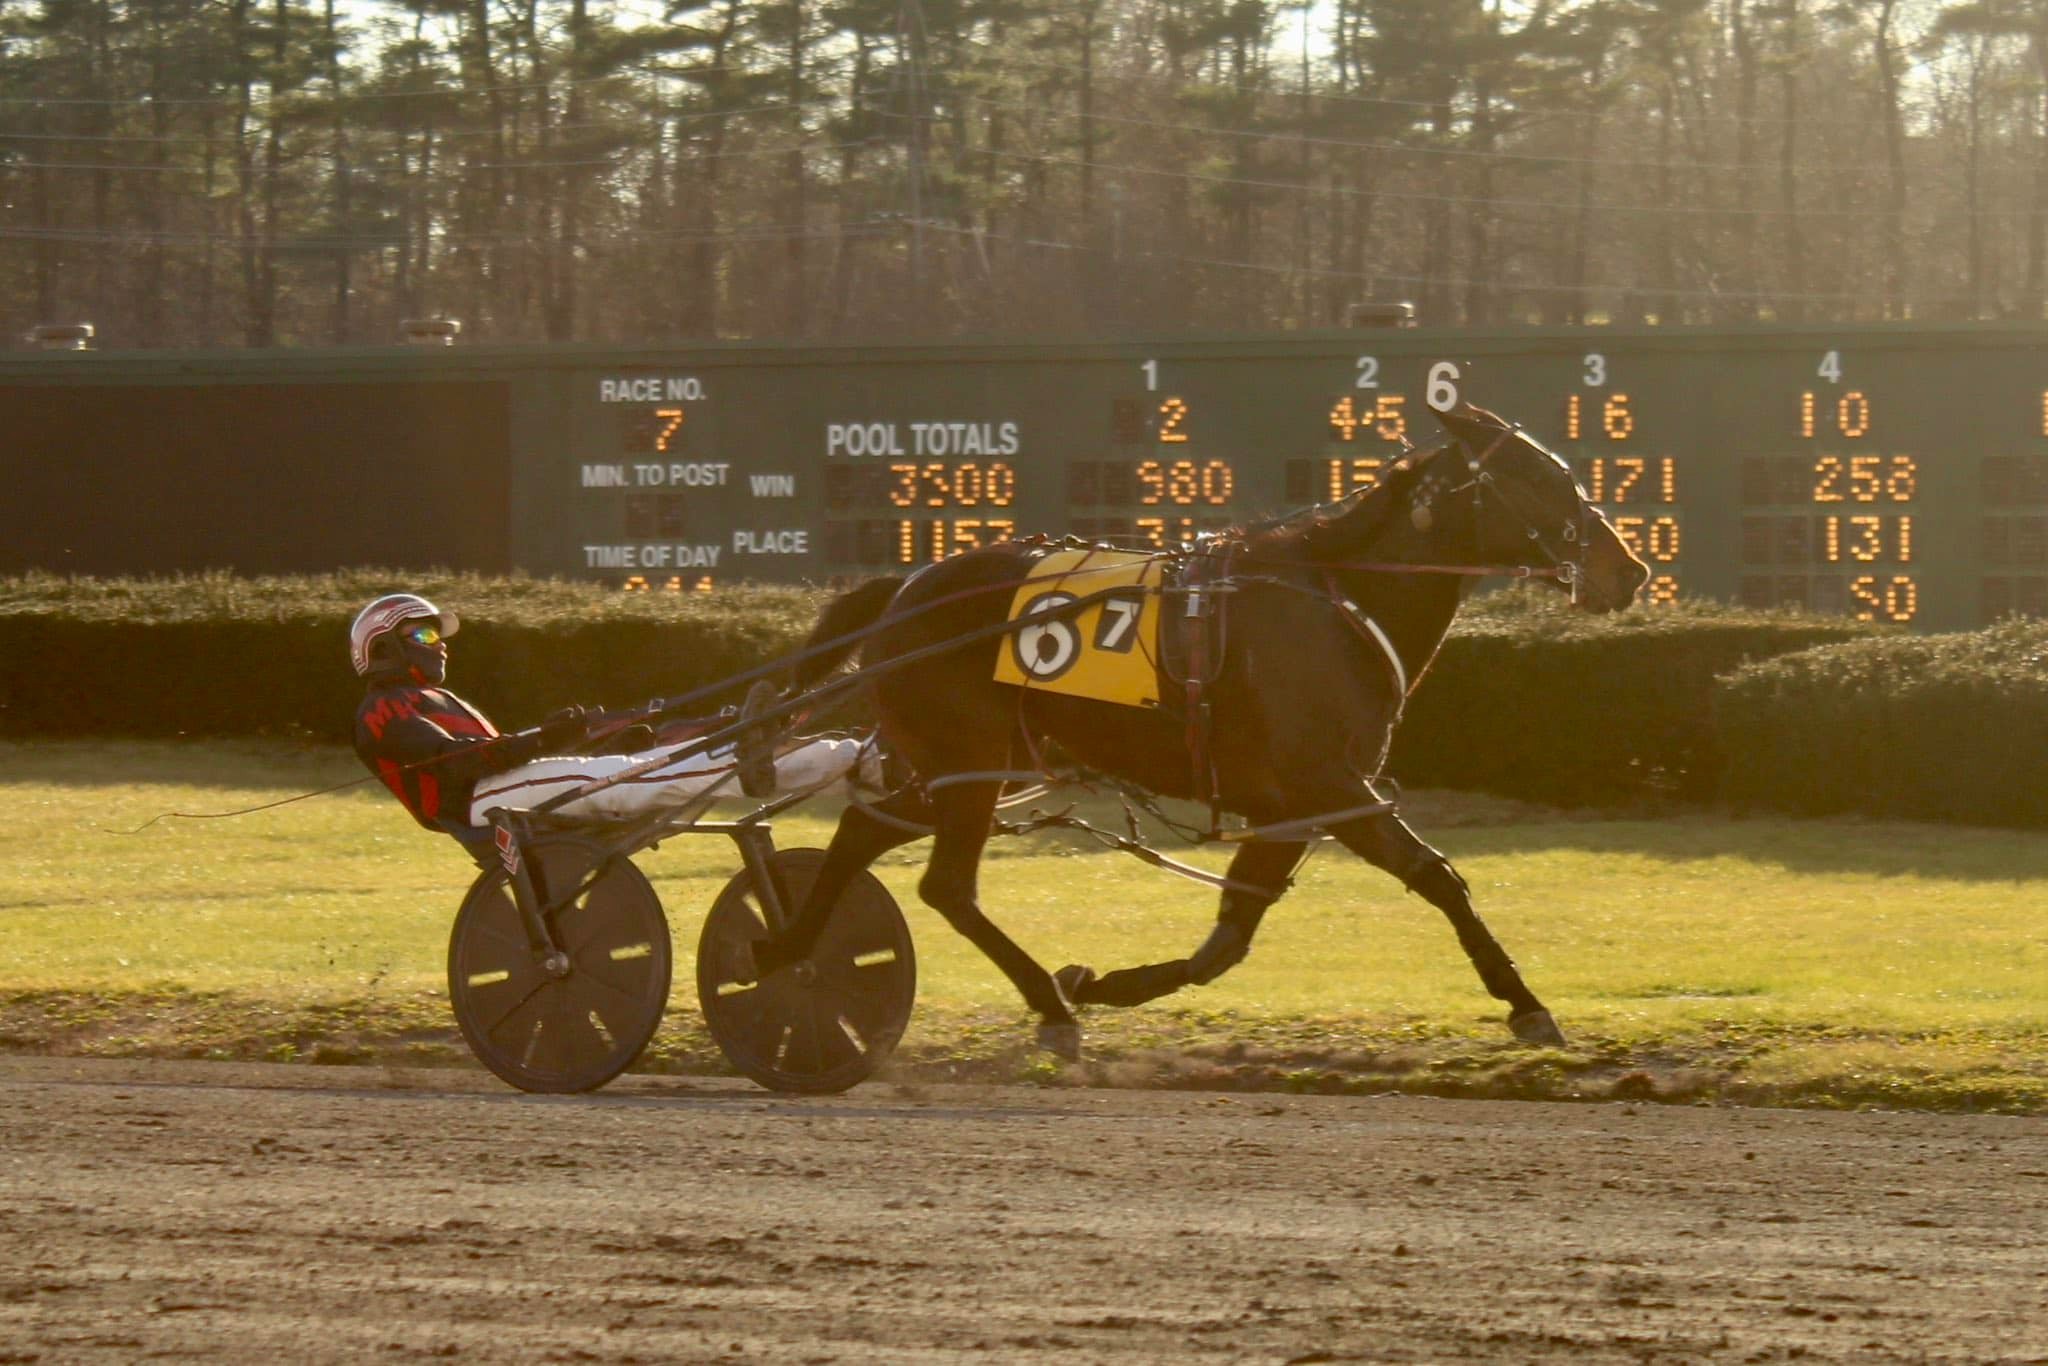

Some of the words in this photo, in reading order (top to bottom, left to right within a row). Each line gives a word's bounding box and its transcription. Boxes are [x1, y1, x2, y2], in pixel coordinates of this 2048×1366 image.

[1141, 360, 1157, 391] 1
[1356, 356, 1379, 389] 2
[1583, 354, 1606, 387] 3
[1817, 351, 1842, 384] 4
[600, 379, 663, 402] RACE
[666, 378, 707, 401] NO.
[1426, 361, 1460, 413] 6
[655, 408, 683, 451] 7
[1160, 398, 1188, 442] 2
[827, 423, 905, 457] POOL
[909, 422, 1019, 455] TOTALS
[581, 464, 630, 487] MIN.
[634, 464, 665, 486] TO
[669, 463, 730, 486] POST
[749, 474, 795, 497] WIN
[1591, 458, 1675, 503] 171
[1813, 456, 1917, 501] 258
[732, 530, 809, 554] PLACE
[1826, 516, 1911, 562] 131
[583, 545, 636, 568] TIME
[640, 545, 672, 568] OF
[676, 545, 722, 568] DAY
[1018, 596, 1074, 676] 6
[1101, 599, 1141, 649] 7
